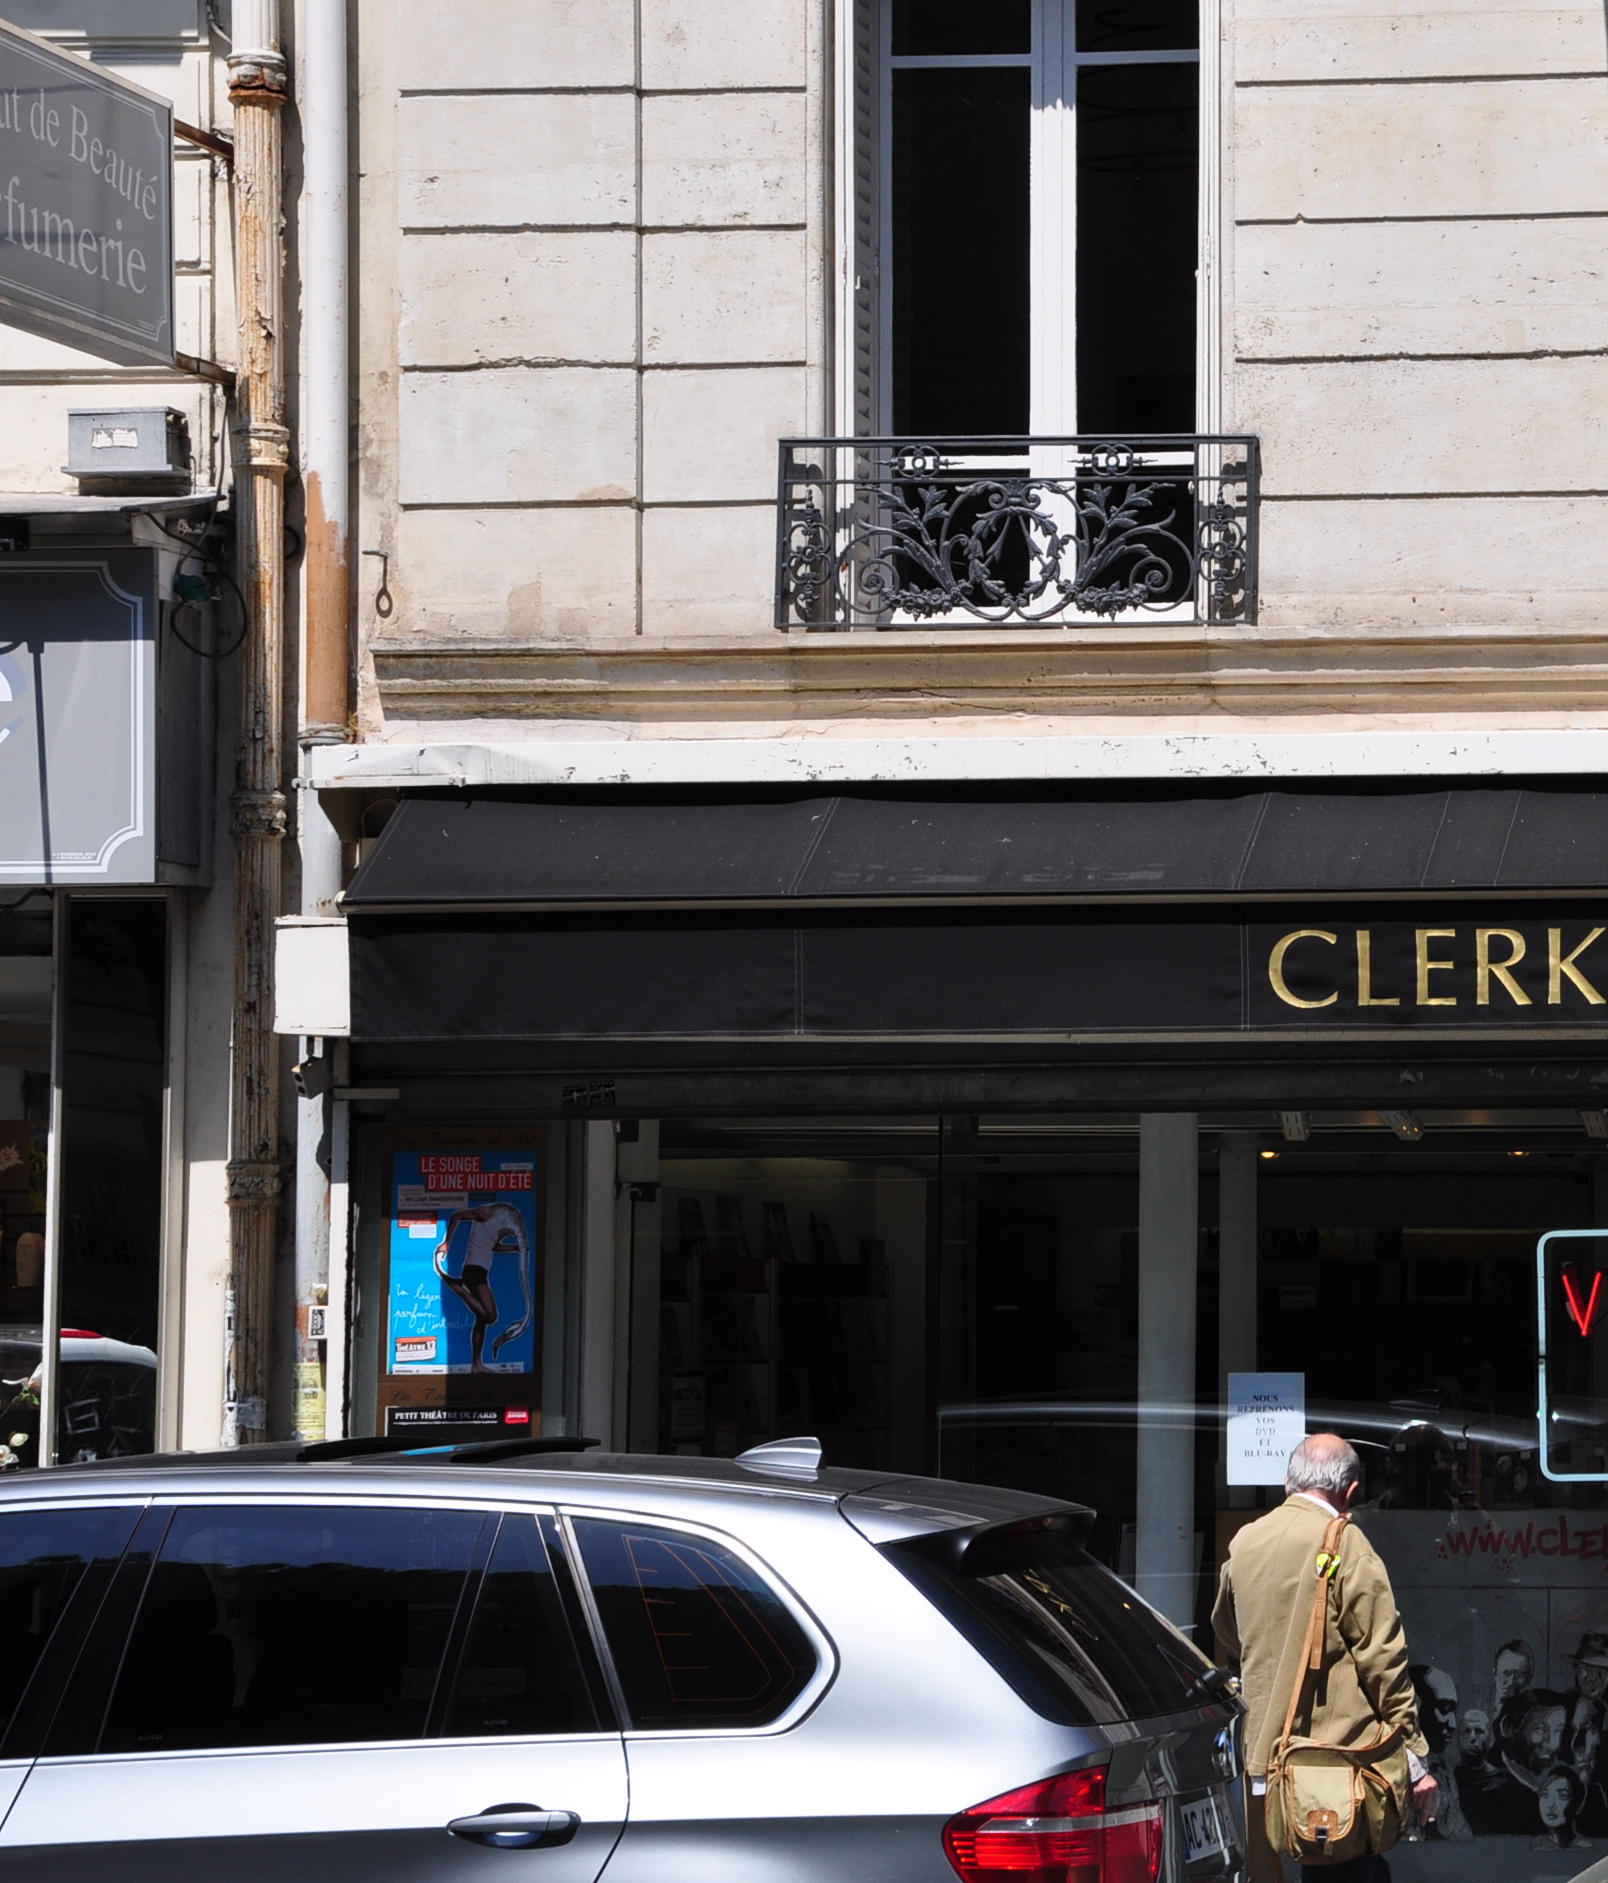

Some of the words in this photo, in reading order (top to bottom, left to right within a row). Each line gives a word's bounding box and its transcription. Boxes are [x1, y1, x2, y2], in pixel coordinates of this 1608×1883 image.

[30, 88, 61, 148] de
[69, 103, 157, 221] Beauté
[421, 1156, 437, 1173] LE
[439, 1156, 480, 1173] SONGE
[427, 1173, 464, 1190] D'UNE
[467, 1173, 495, 1189] NUIT
[498, 1170, 532, 1189] D'ÉTÉ
[426, 1340, 436, 1350] 13
[1252, 1394, 1279, 1403] NOUS
[1237, 1405, 1295, 1413] REPRENONS
[394, 1411, 418, 1420] PETIT
[420, 1410, 458, 1420] THÉÂTRE
[459, 1412, 471, 1420] DE
[473, 1411, 498, 1420] PARIS
[1259, 1439, 1271, 1447] ET
[1244, 1450, 1287, 1458] BLU-RAY
